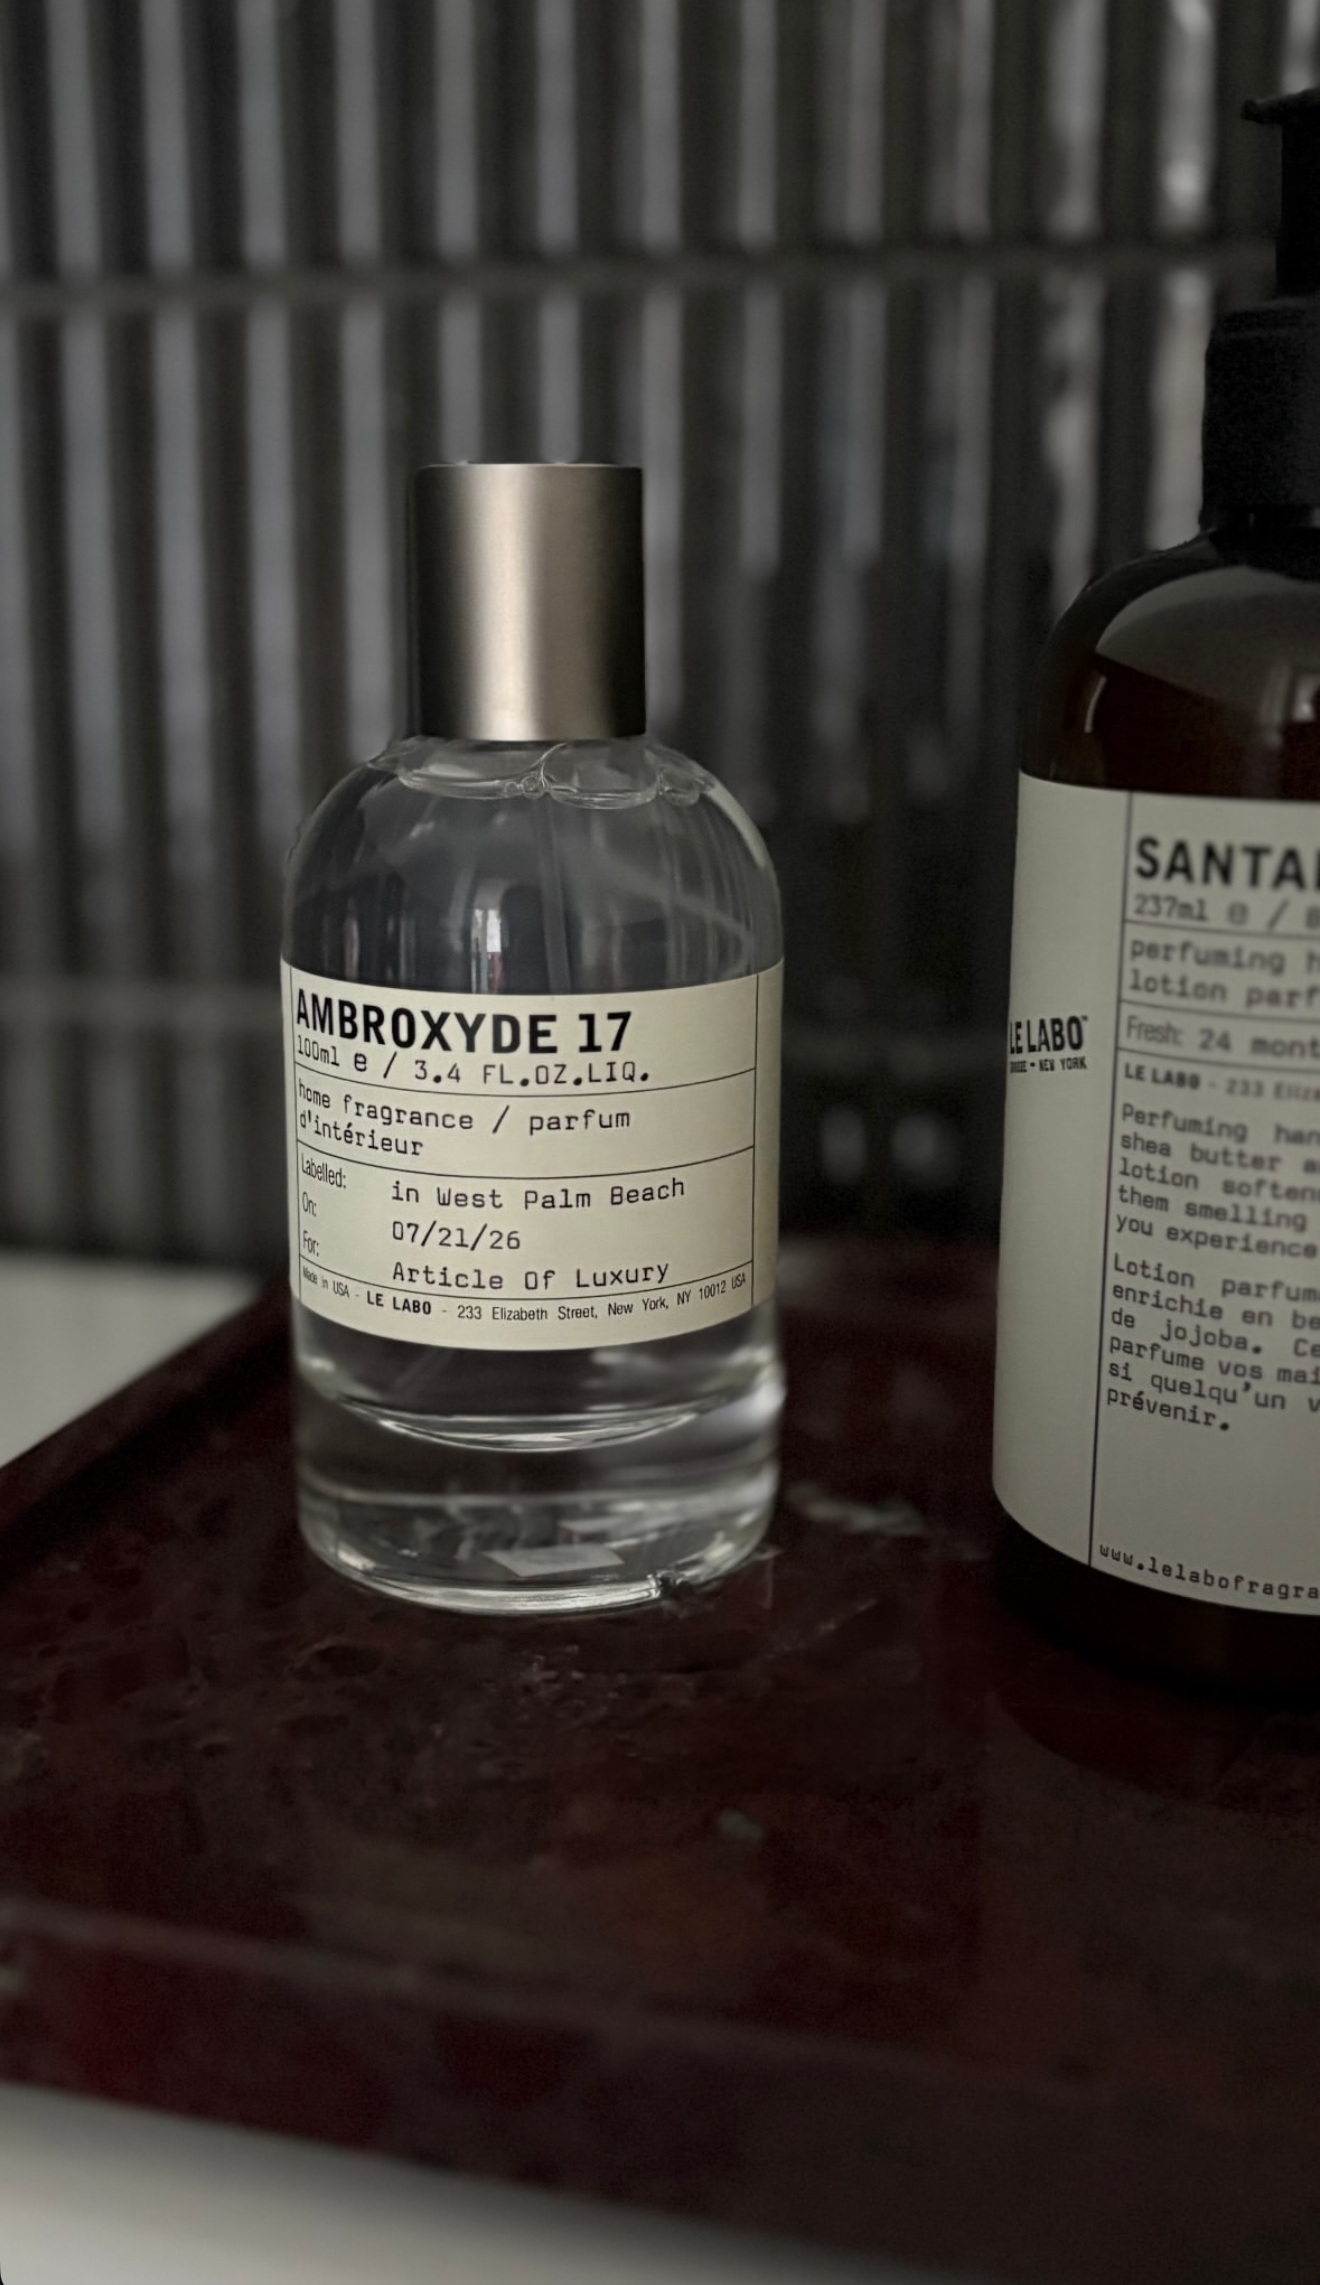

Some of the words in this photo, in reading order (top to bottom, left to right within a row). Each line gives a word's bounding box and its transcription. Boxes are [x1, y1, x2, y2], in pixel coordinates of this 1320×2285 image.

[1134, 836, 1320, 891] SANTA
[1130, 938, 1286, 976] perfuming
[1129, 968, 1227, 1002] lotion
[296, 987, 558, 1054] AMBROXYDE
[578, 1010, 632, 1053] 17
[1126, 1014, 1183, 1048] Fresh:
[1199, 1027, 1232, 1052] 24
[297, 1034, 340, 1067] 100ml
[382, 1051, 398, 1079] /
[414, 1059, 461, 1084] 3.4
[483, 1061, 650, 1088] FL.OZ.LIQ.
[1060, 1055, 1088, 1071] YORK
[1124, 1062, 1146, 1082] LE
[1151, 1066, 1200, 1091] LABO
[299, 1077, 331, 1109] home
[344, 1093, 474, 1131] fragrance
[492, 1105, 511, 1134] /
[529, 1108, 631, 1136] parfum
[1121, 1103, 1248, 1143] Perfuming
[299, 1109, 424, 1156] d'intérieur
[1120, 1131, 1172, 1159] shea
[1190, 1142, 1282, 1175] butter
[301, 1152, 347, 1189] Labelled:
[391, 1179, 420, 1203] in
[436, 1186, 504, 1210] West
[524, 1189, 592, 1211] Palm
[610, 1177, 686, 1206] Beach
[1118, 1157, 1199, 1191] lotion
[1222, 1178, 1320, 1204] soften
[302, 1190, 317, 1218] On:
[392, 1219, 521, 1252] 07/21/26
[1117, 1184, 1169, 1214] them
[1185, 1201, 1307, 1234] smelling
[1115, 1212, 1154, 1239] you
[1166, 1225, 1318, 1260] experience
[302, 1229, 319, 1257] For:
[392, 1261, 504, 1291] Article
[524, 1269, 556, 1291] Of
[576, 1262, 669, 1289] Luxury
[1113, 1252, 1195, 1289] Lotion
[1221, 1278, 1320, 1304] parfum
[333, 1279, 351, 1299] USA
[366, 1290, 384, 1308] LE
[393, 1296, 432, 1316] LABO
[456, 1304, 483, 1320] 233
[492, 1306, 549, 1321] Elizabeth
[557, 1304, 599, 1321] Street,
[607, 1301, 634, 1317] New
[642, 1293, 670, 1312] York,
[677, 1290, 692, 1306] NY
[699, 1283, 727, 1300] 10012
[731, 1271, 747, 1291] USA
[1112, 1283, 1224, 1321] enrichie
[1241, 1309, 1274, 1328] en
[1112, 1307, 1136, 1330] de
[1160, 1318, 1263, 1355] jojoba.
[1108, 1361, 1132, 1382] si
[1110, 1334, 1205, 1371] parfume
[1218, 1358, 1264, 1380] vos
[1107, 1387, 1231, 1432] prévenir.
[1099, 1543, 1319, 1601] www.lelabofragra
